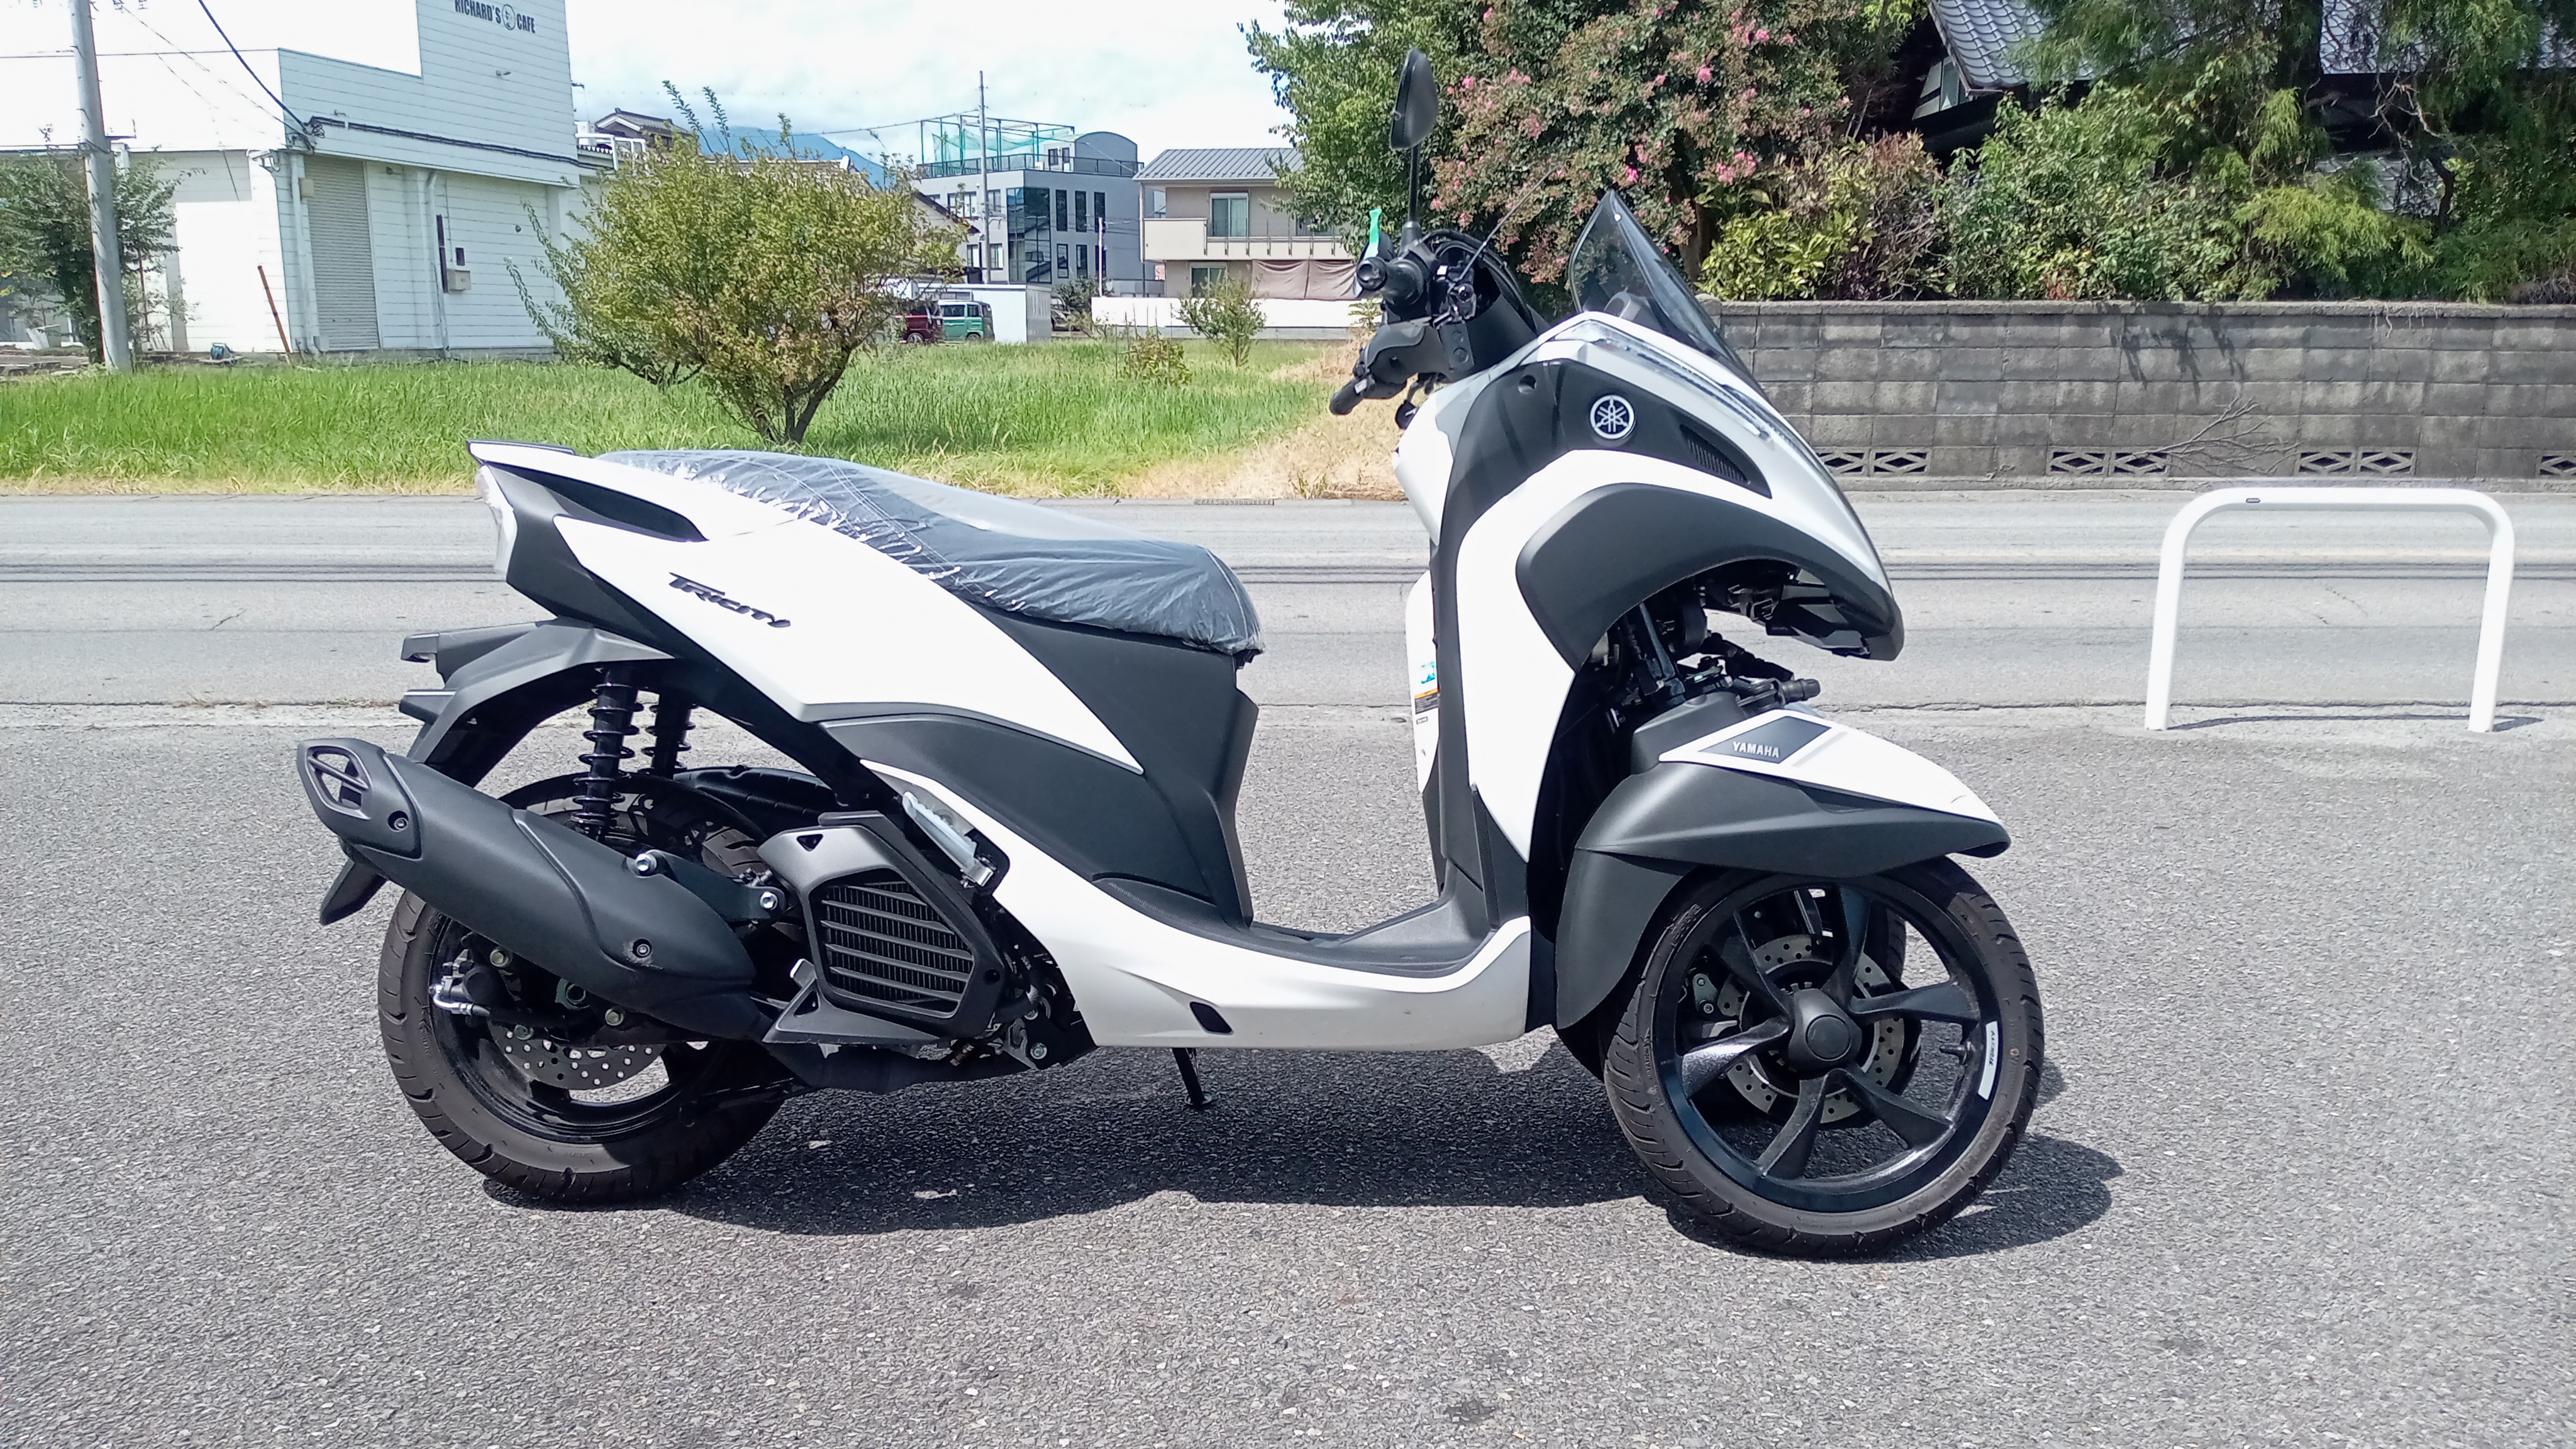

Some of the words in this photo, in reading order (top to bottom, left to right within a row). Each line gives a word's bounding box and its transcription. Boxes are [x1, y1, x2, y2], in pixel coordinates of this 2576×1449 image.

[455, 0, 501, 24] RICHARD'S
[516, 13, 535, 33] CAFE
[669, 572, 791, 628] TRICITY
[1733, 741, 1779, 758] YAMAHA
